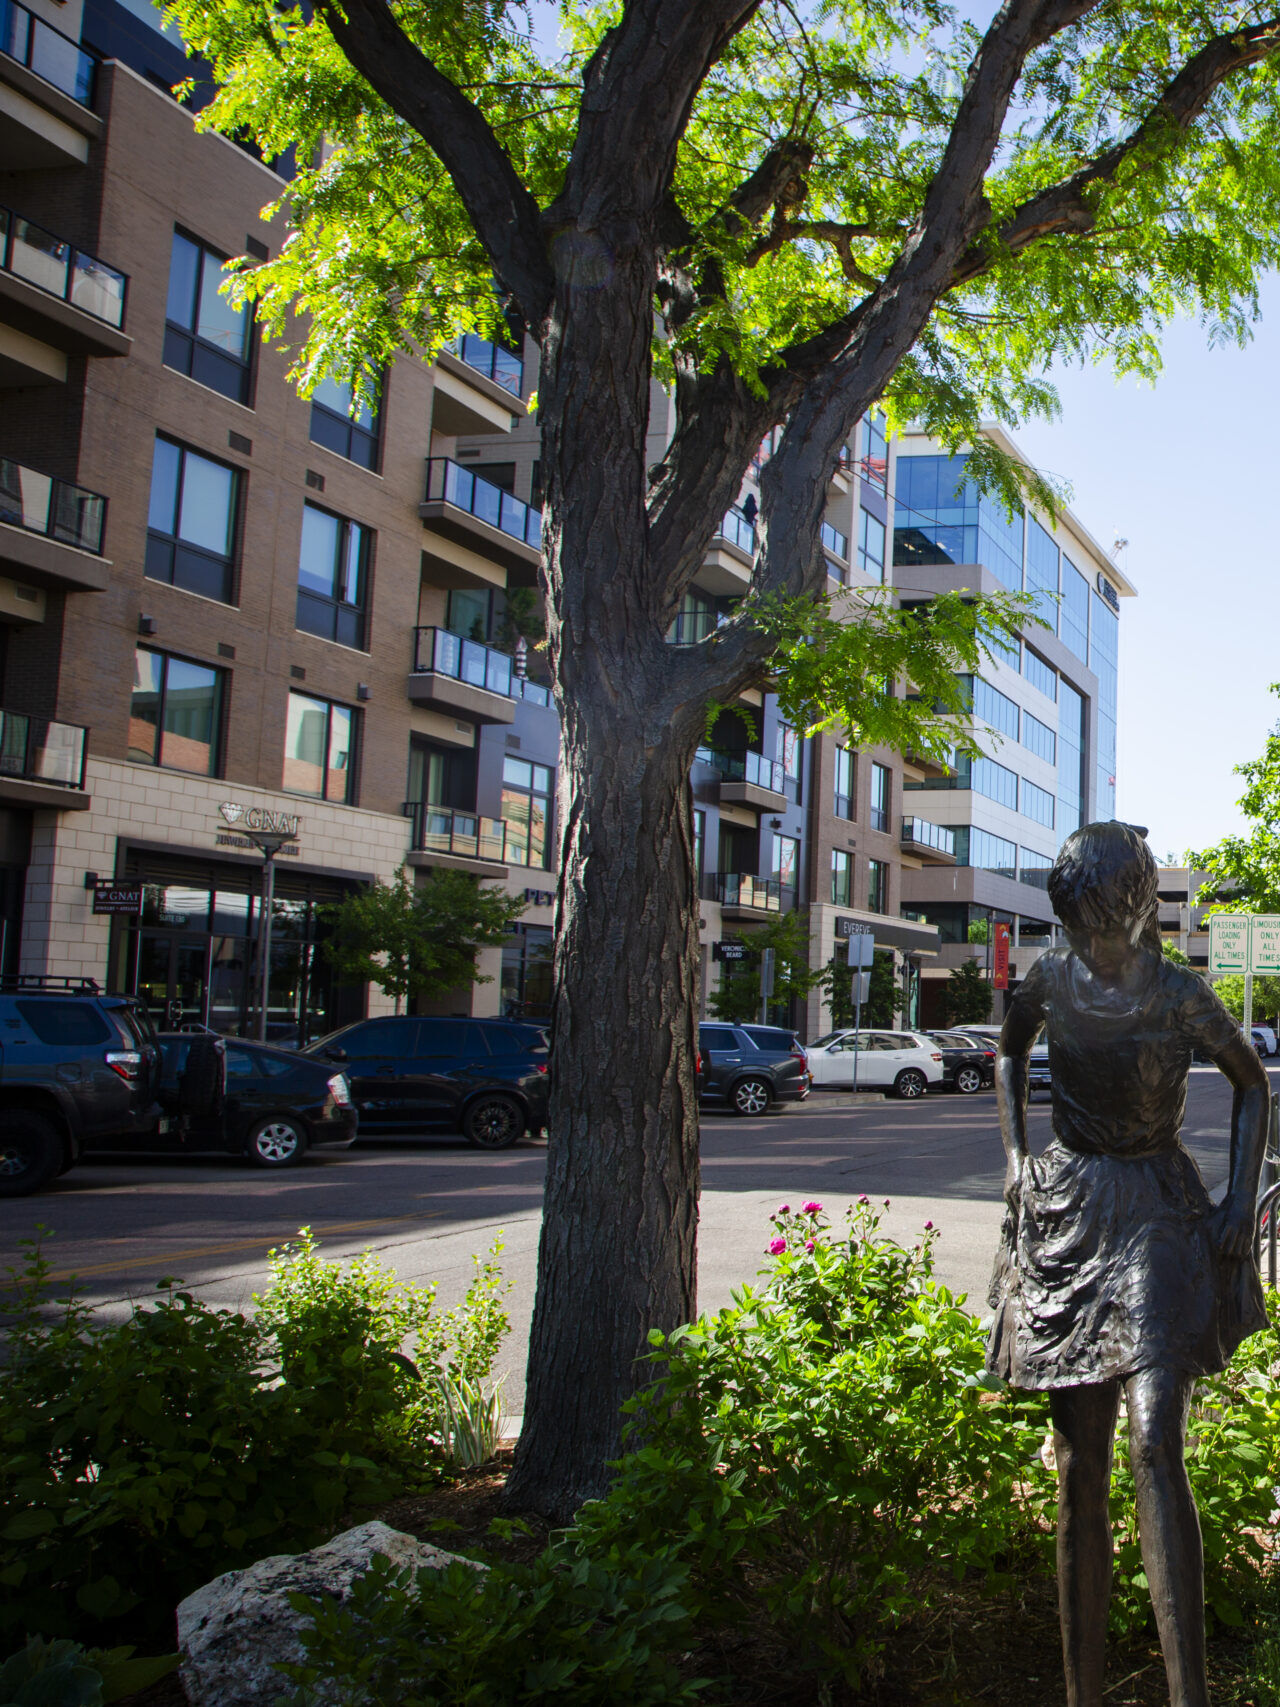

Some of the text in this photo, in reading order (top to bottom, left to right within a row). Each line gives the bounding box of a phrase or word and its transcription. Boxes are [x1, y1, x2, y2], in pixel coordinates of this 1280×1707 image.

[246, 807, 301, 835] GNAT
[109, 892, 140, 901] GNAT
[1213, 921, 1246, 929] PASSENGER
[1218, 931, 1240, 939] LOADING
[1222, 941, 1236, 949] ONLY
[1214, 951, 1245, 959] ALL TIMES
[1259, 953, 1280, 961] TIMES
[998, 950, 1006, 970] VISIT
